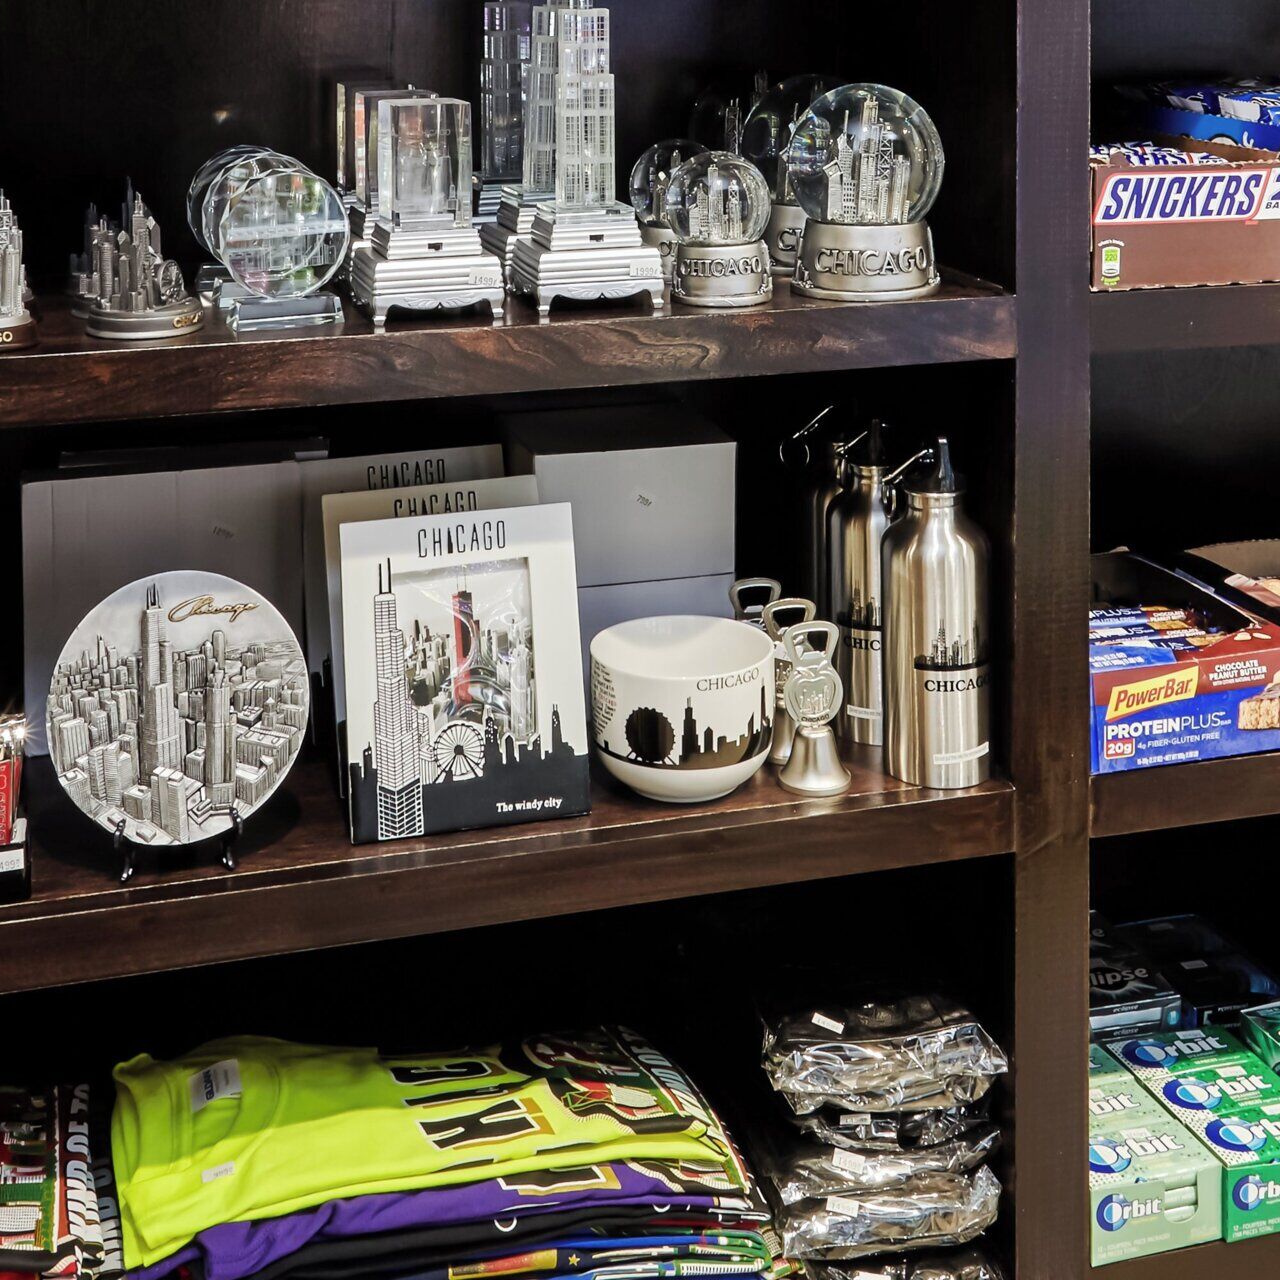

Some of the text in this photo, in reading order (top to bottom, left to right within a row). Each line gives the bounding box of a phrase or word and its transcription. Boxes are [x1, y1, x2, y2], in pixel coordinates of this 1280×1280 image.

[1102, 174, 1257, 220] SNICKERS
[417, 520, 507, 557] CHICAGO
[167, 594, 259, 623] Chicago
[696, 667, 759, 693] CHICAGO
[1209, 666, 1267, 680] PEANUT BUTTER
[1114, 679, 1192, 712] PowerBar
[1107, 712, 1221, 740] PROTEIN PLUS
[1107, 741, 1132, 756] 20g
[496, 797, 563, 813] The windy city
[1096, 1192, 1162, 1232] Orbit
